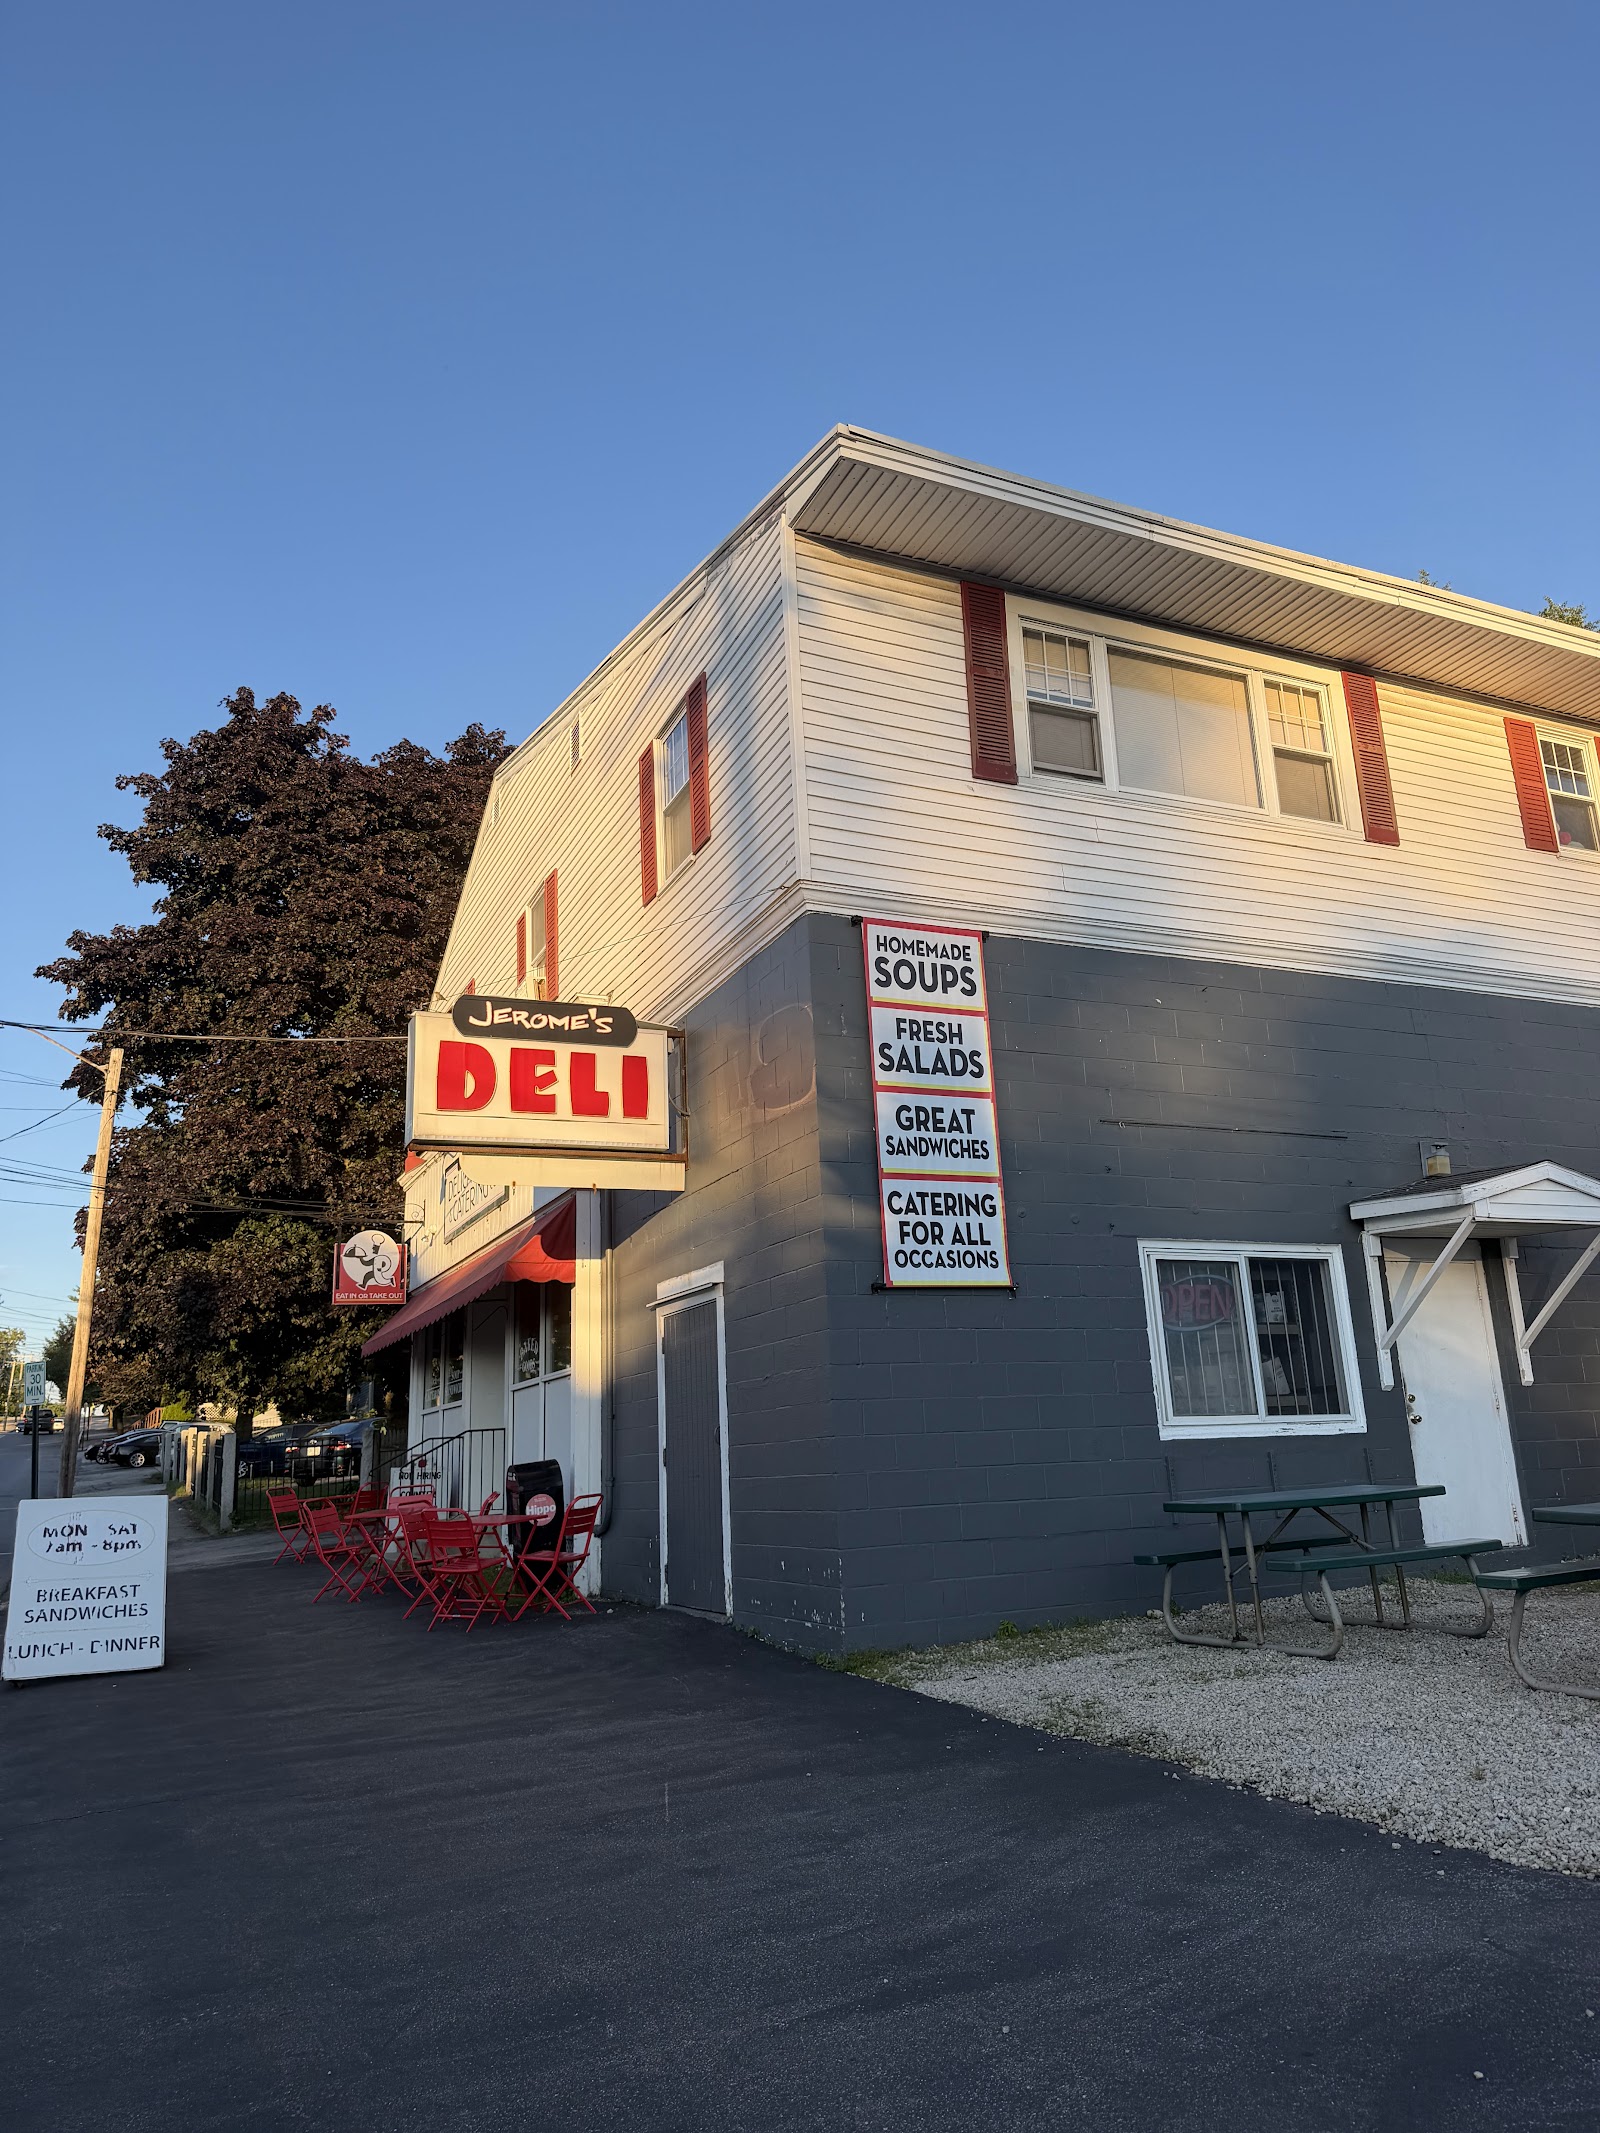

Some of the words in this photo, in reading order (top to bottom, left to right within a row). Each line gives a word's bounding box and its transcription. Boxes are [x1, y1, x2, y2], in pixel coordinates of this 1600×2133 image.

[876, 934, 972, 962] HOMEMADE
[874, 956, 977, 997] SOUPS
[468, 1000, 613, 1034] JEROME'S
[895, 1017, 964, 1045] FRESH
[878, 1042, 984, 1079] SALADS
[436, 1040, 649, 1120] DELI
[895, 1104, 975, 1135] GREAT
[885, 1135, 990, 1160] SANDWICHES
[887, 1190, 997, 1218] CATERING
[899, 1220, 944, 1246] FOR
[951, 1221, 991, 1246] ALL
[894, 1249, 999, 1269] OCCASIONS
[1162, 1284, 1230, 1321] OPEN
[26, 1385, 44, 1397] MIN.
[30, 1373, 41, 1385] 30
[526, 1504, 556, 1516] Hippo
[43, 1524, 88, 1539] MON
[36, 1584, 141, 1603] BREAKFAST
[24, 1603, 149, 1624] SANDWICHES
